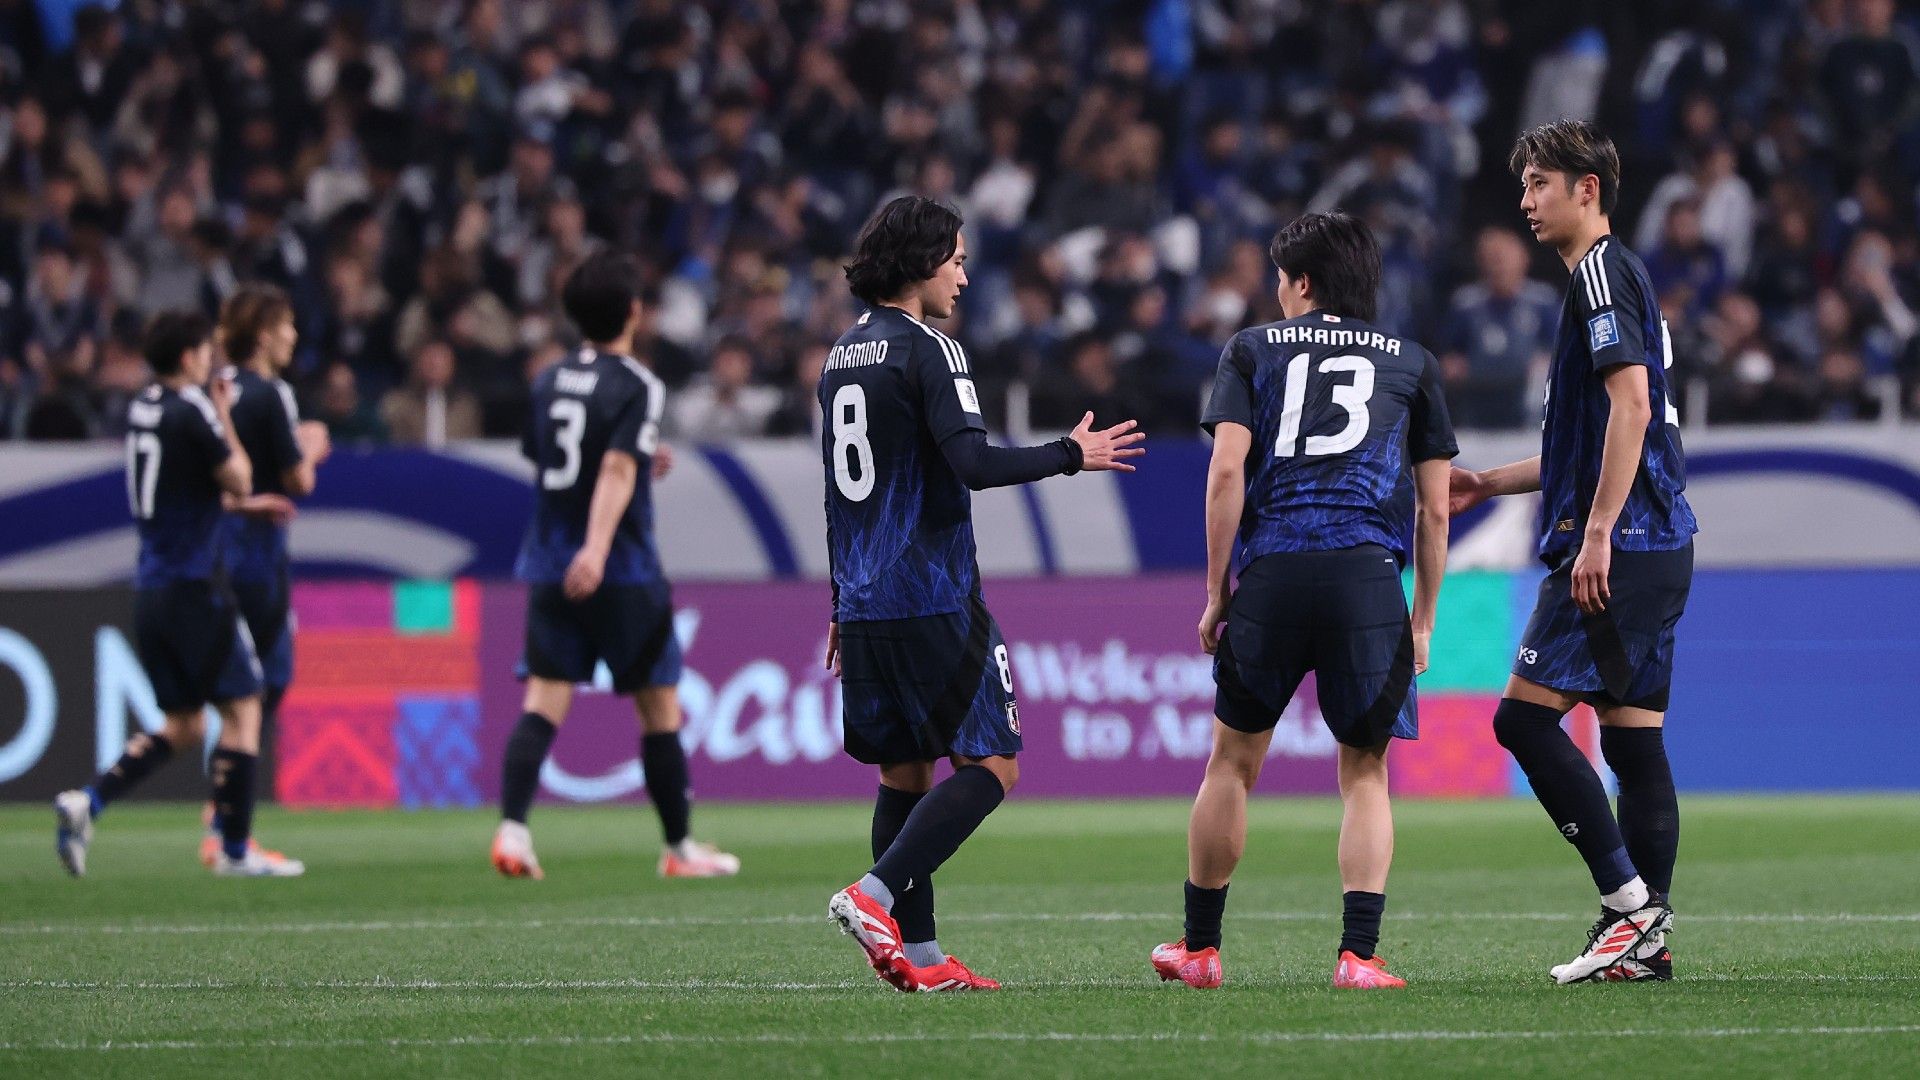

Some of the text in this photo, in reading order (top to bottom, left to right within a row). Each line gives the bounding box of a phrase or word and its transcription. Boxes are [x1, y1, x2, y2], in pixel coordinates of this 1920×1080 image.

[1266, 326, 1401, 357] NAKAMURA
[832, 383, 876, 502] 8
[1274, 352, 1376, 457] 13
[125, 429, 163, 520] 17
[542, 398, 587, 490] 3
[994, 643, 1014, 693] 8
[1011, 640, 1218, 702] Welco
[1061, 706, 1134, 762] to
